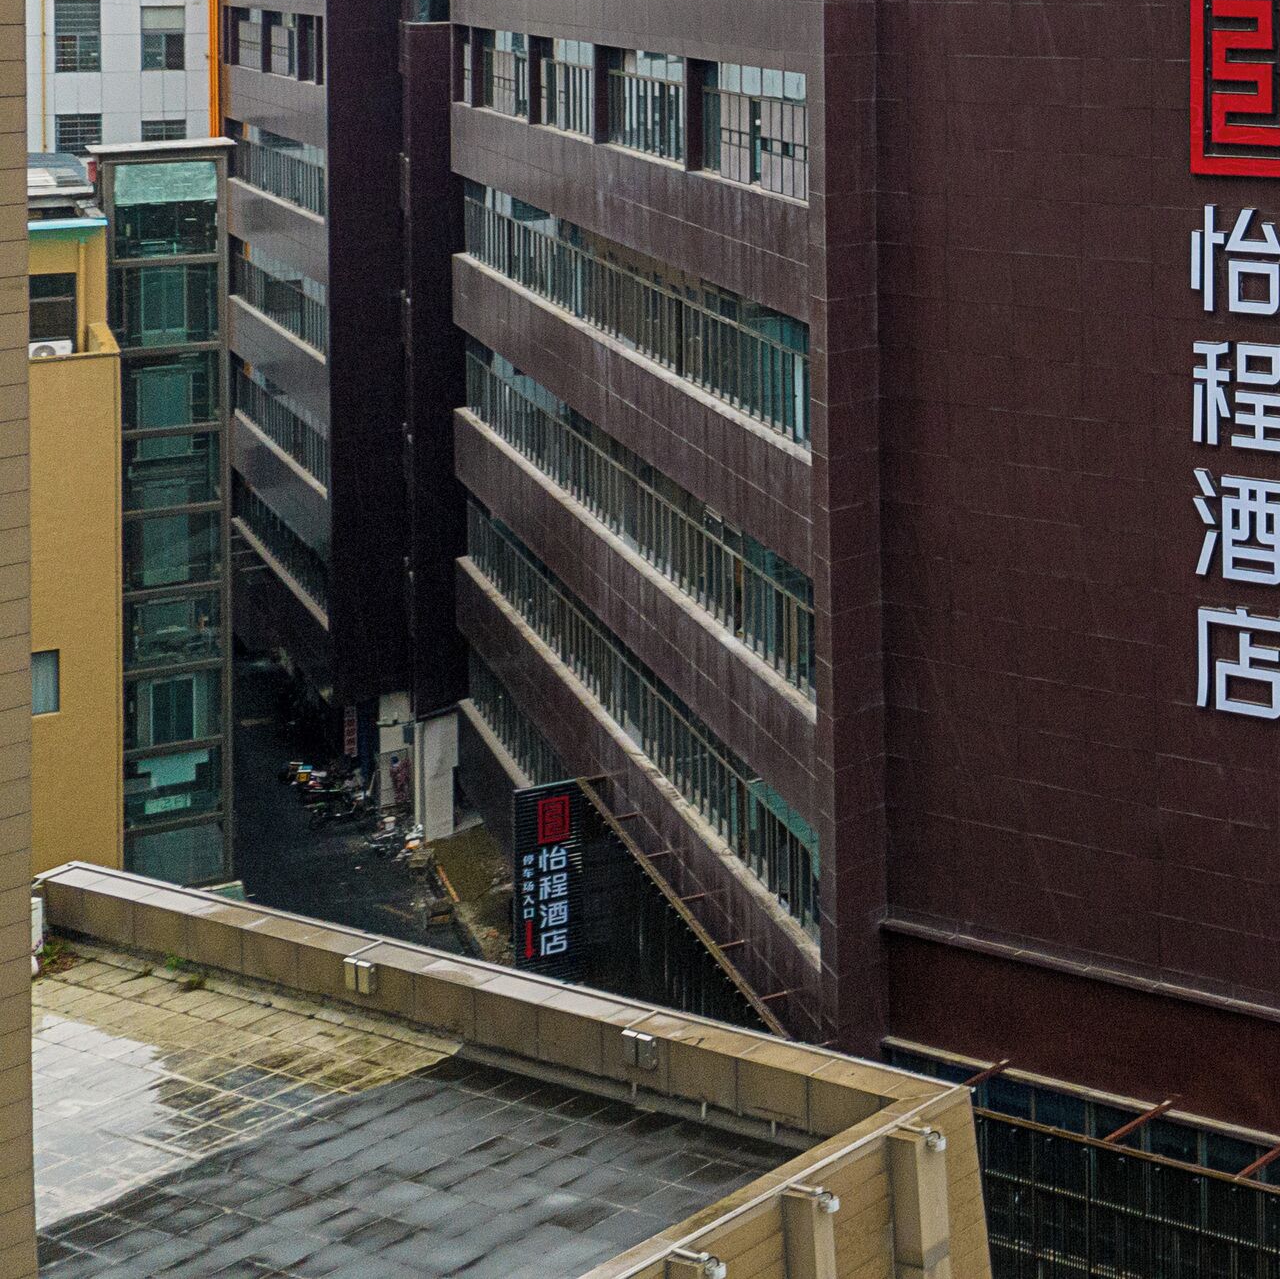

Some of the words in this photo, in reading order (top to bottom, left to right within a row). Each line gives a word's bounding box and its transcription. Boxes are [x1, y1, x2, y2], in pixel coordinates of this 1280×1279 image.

[523, 854, 535, 920] 停车场入口
[538, 846, 568, 957] 怡程酒店
